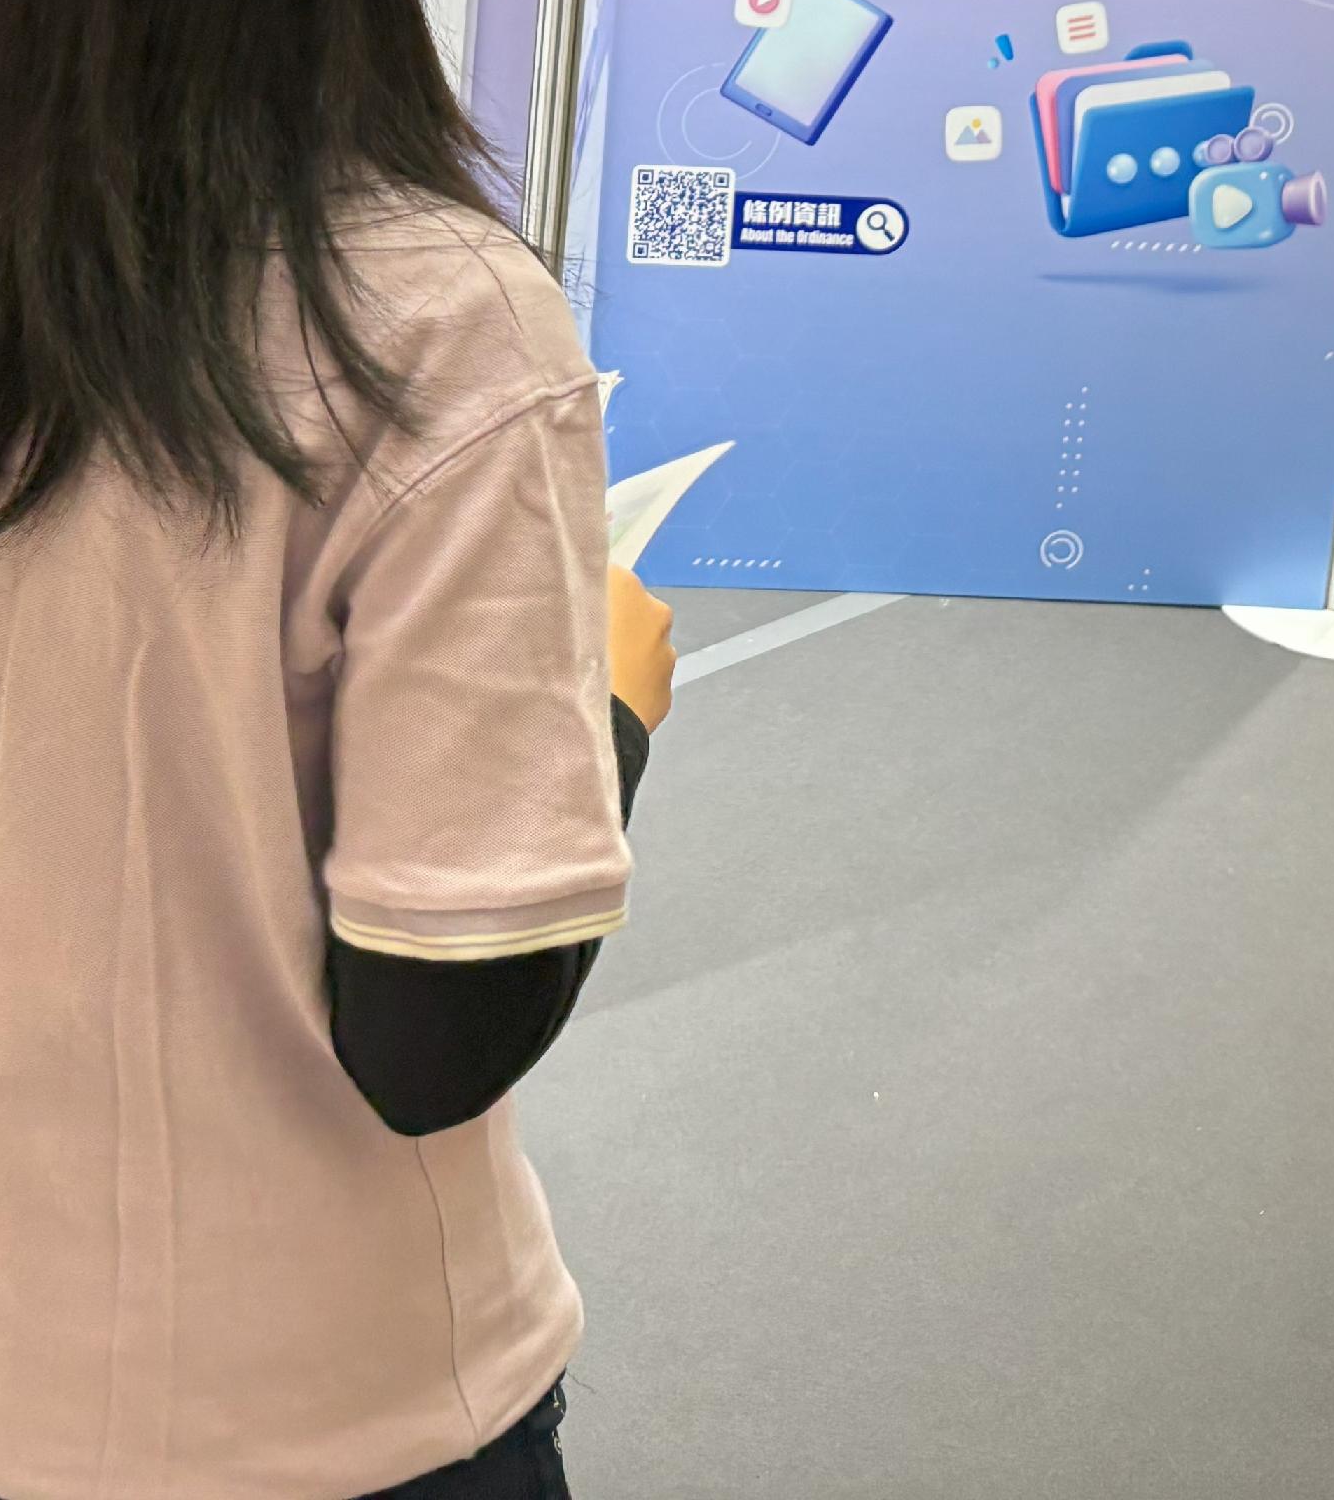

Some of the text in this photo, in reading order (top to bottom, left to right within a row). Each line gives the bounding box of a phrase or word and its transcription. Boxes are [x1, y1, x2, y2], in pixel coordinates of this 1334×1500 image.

[742, 202, 842, 228] 條例資訊
[741, 228, 854, 246] About the Ordinance
